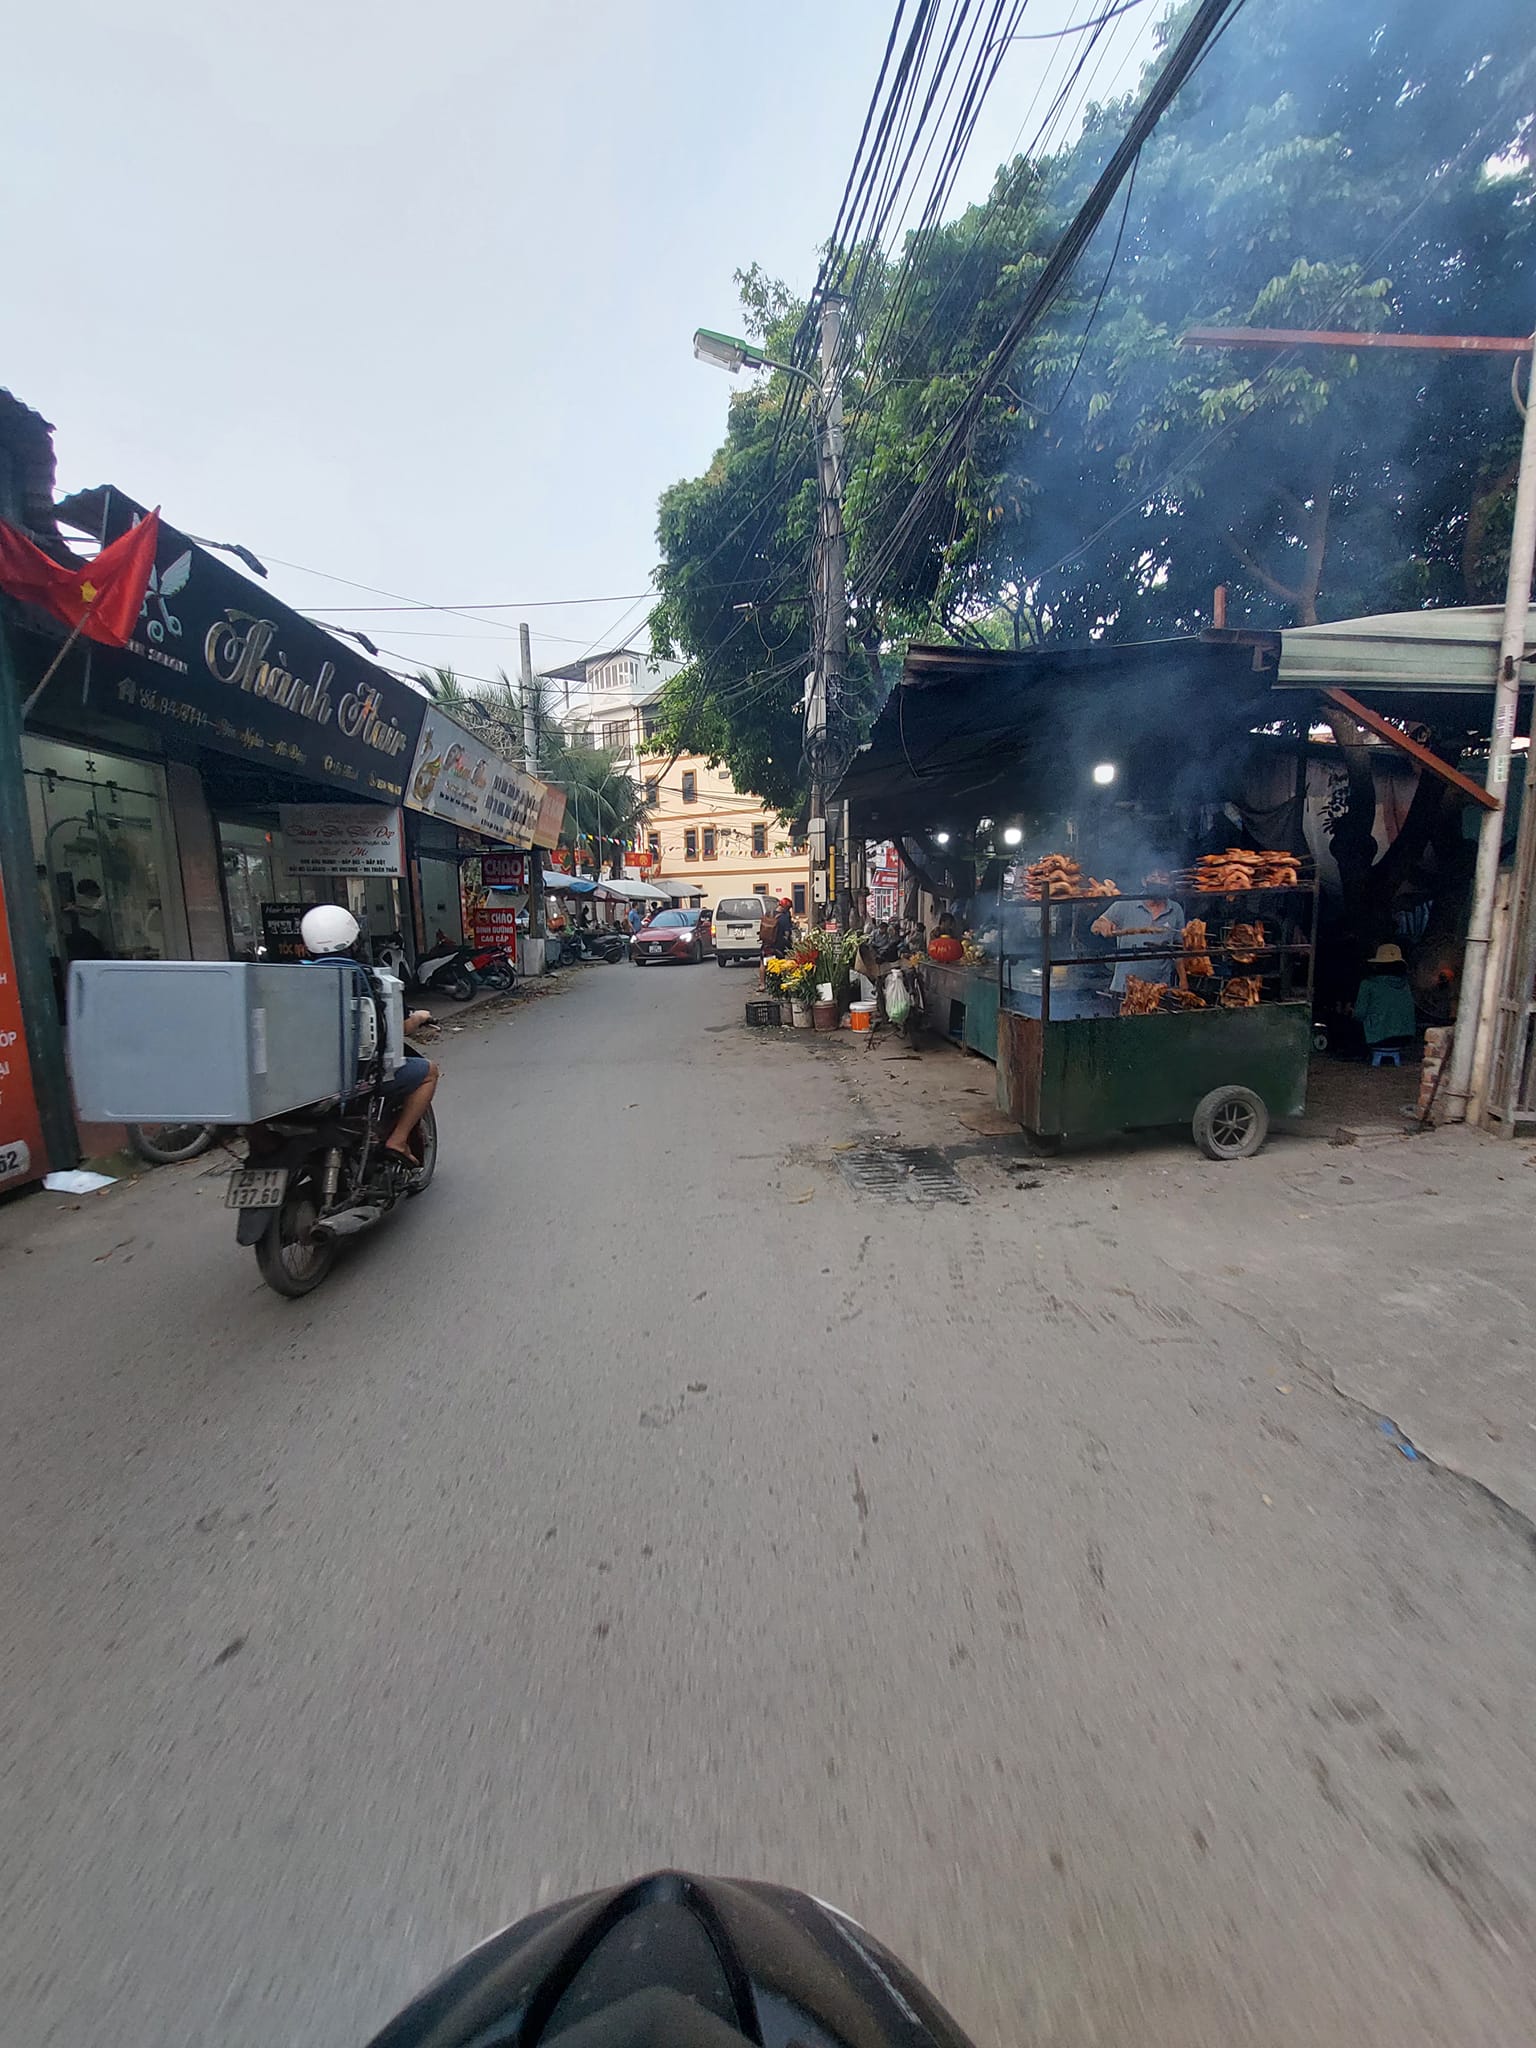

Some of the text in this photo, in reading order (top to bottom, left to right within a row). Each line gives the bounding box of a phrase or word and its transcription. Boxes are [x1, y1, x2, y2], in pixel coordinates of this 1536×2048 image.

[205, 609, 335, 725] Thành
[338, 682, 407, 757] Hair
[484, 857, 522, 876] CHÁO
[491, 910, 513, 924] CHÁO
